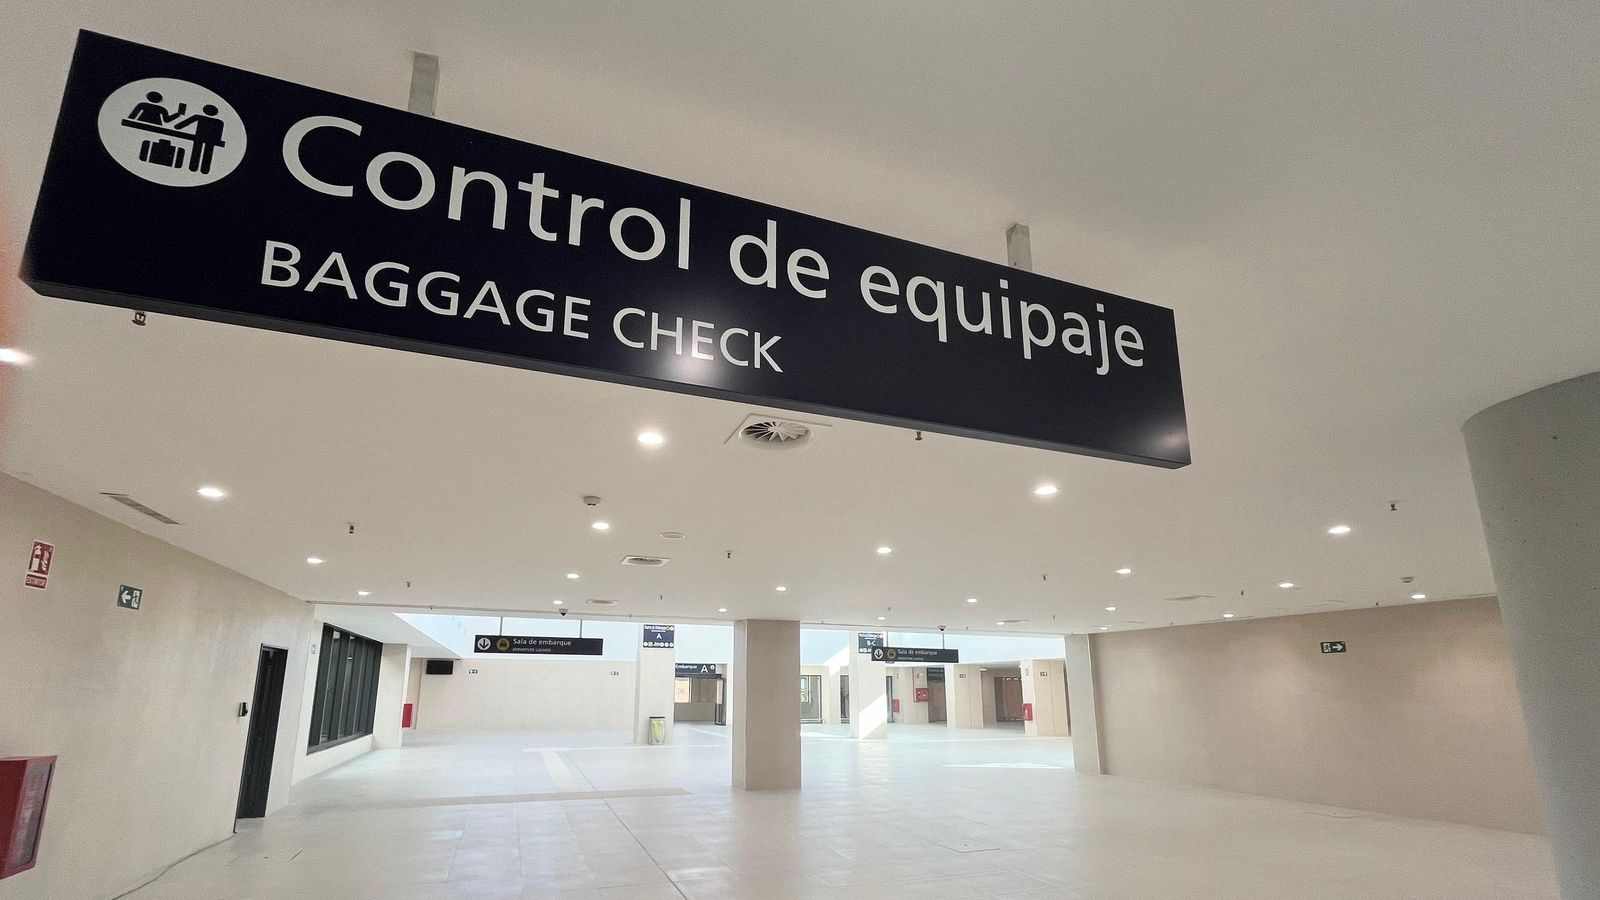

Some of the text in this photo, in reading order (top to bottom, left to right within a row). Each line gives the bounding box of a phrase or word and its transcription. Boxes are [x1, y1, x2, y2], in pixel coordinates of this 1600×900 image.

[282, 115, 1145, 376] Control de equipaje
[260, 239, 785, 374] BAGGAGE CHECK
[538, 639, 572, 647] embarque
[700, 664, 709, 674] A
